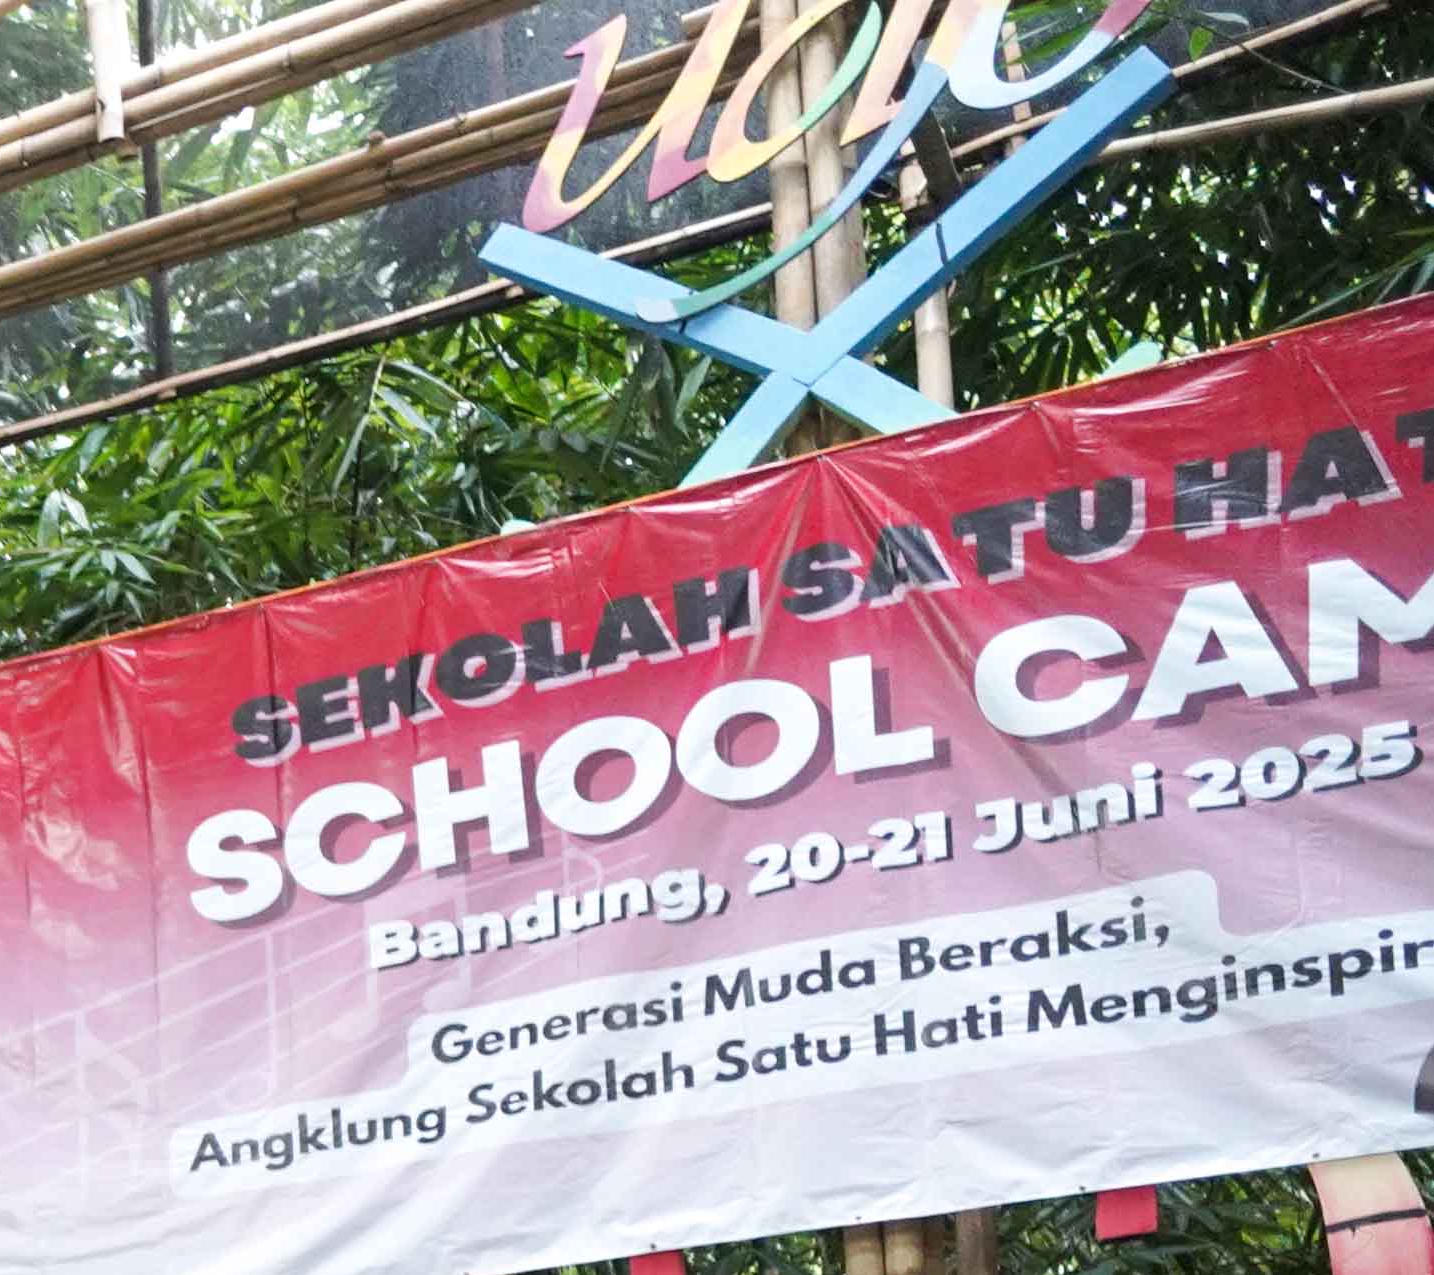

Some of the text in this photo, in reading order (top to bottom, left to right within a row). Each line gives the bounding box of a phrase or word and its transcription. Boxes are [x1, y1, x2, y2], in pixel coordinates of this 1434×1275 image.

[232, 566, 758, 767] SEKOLAH
[781, 476, 1145, 622] SATU
[186, 655, 942, 922] SCHOOL
[368, 721, 1422, 970] Bandung, 20-21 Juni 2025
[190, 1108, 447, 1172] Angklung
[465, 1052, 695, 1124] Sekolah
[715, 1030, 851, 1082] Satu
[875, 996, 1002, 1056] Hati
[431, 896, 1170, 1064] Generasi Muda Beraksi,
